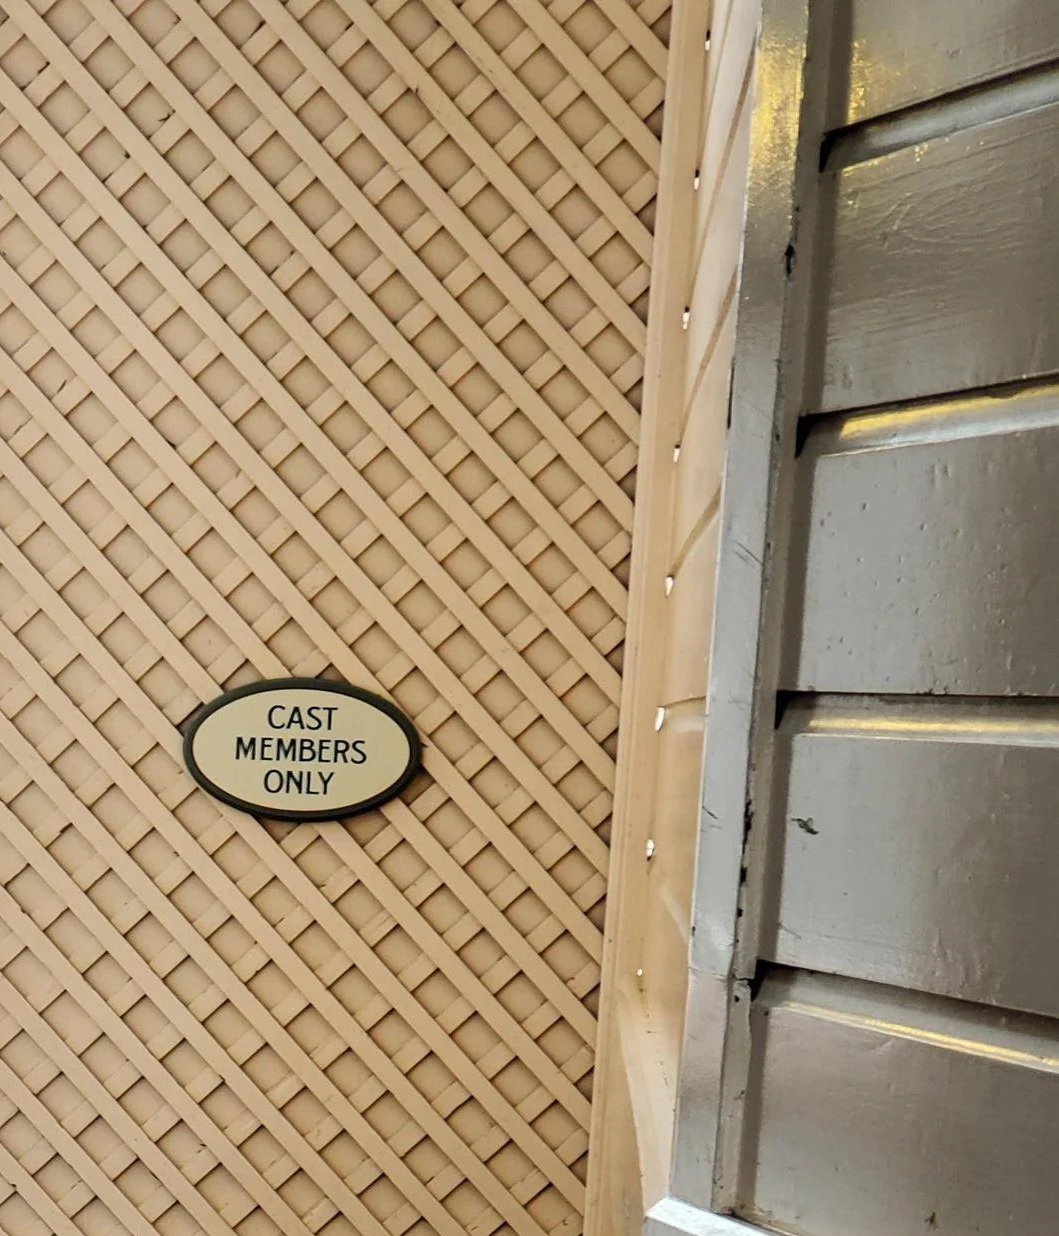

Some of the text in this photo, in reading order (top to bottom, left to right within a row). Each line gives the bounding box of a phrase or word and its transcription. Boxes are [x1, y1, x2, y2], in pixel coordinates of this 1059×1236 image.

[267, 704, 339, 731] CAST
[235, 736, 367, 765] MEMBERS
[263, 769, 335, 796] ONLY
